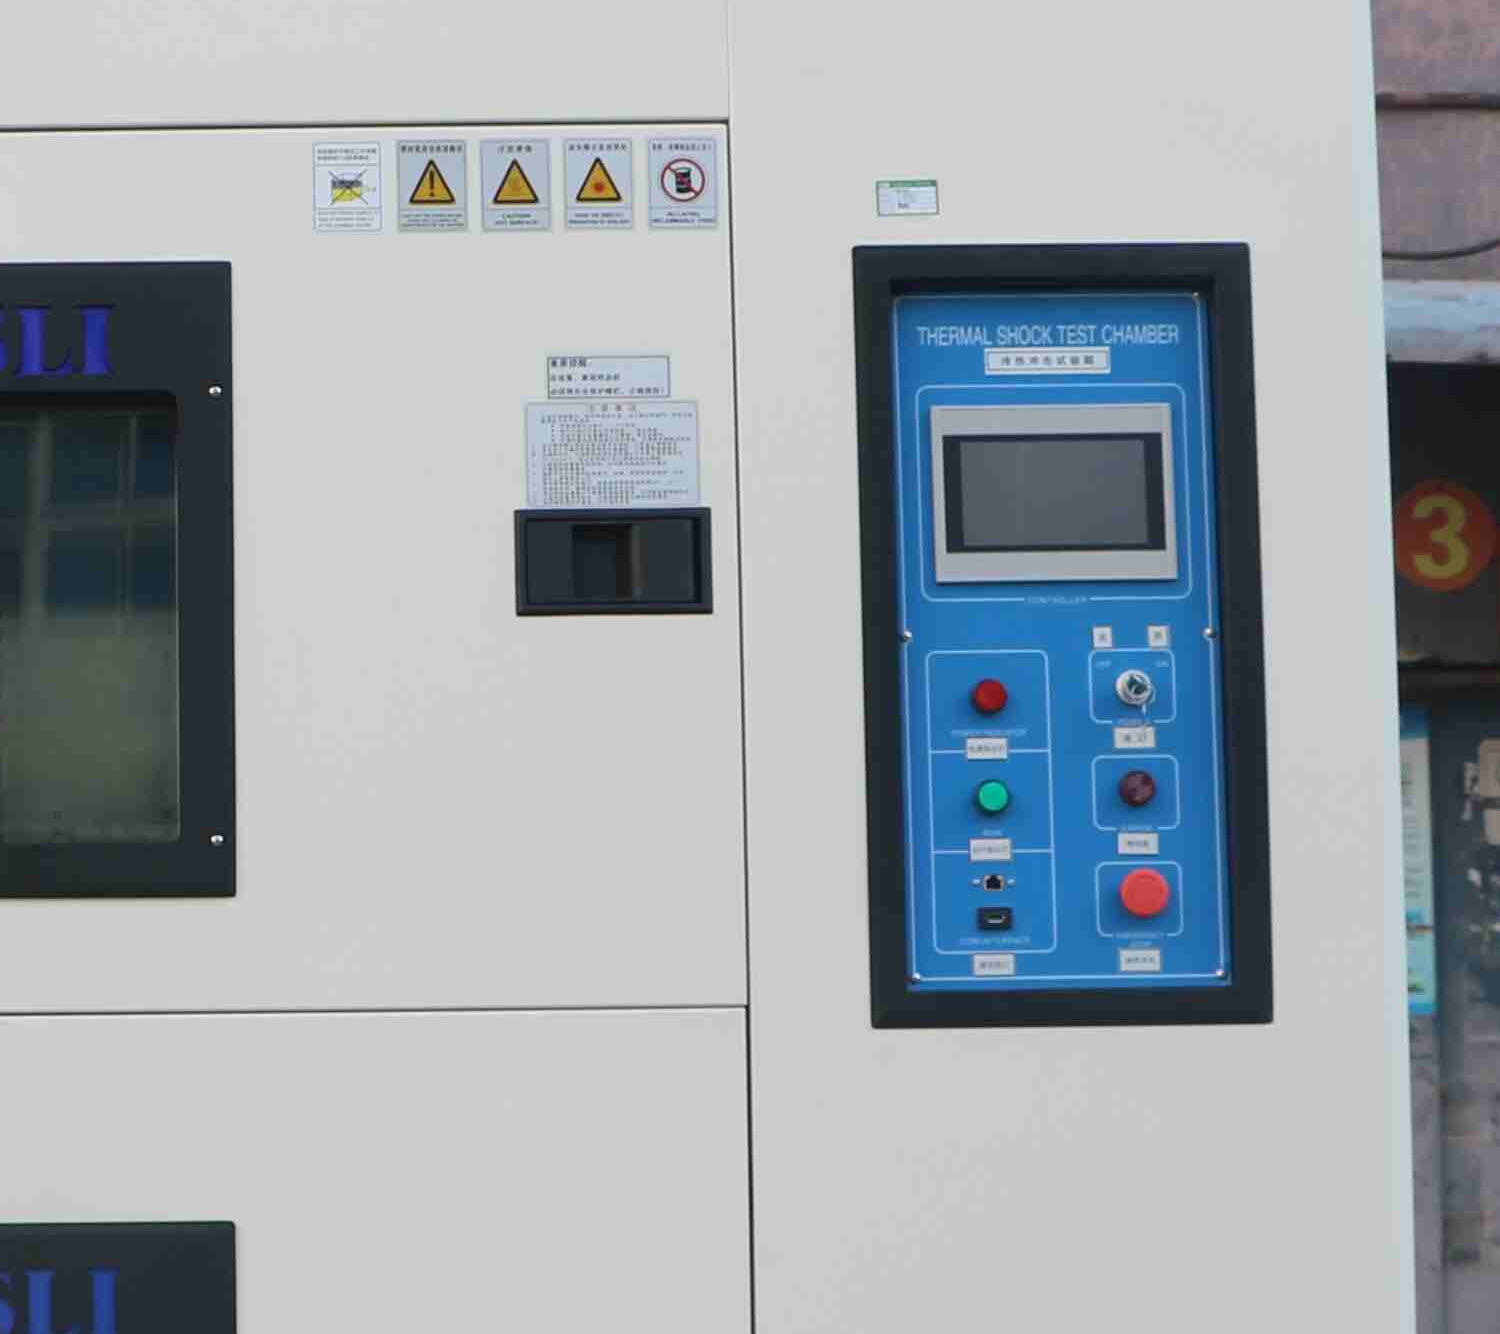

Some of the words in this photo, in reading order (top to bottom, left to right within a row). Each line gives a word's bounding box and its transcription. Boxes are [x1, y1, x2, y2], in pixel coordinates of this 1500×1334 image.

[916, 326, 993, 347] THERMAL
[997, 325, 1054, 346] SHOCK
[1056, 324, 1096, 345] TEST
[1101, 324, 1181, 345] CHAMBER
[1412, 494, 1470, 579] 3
